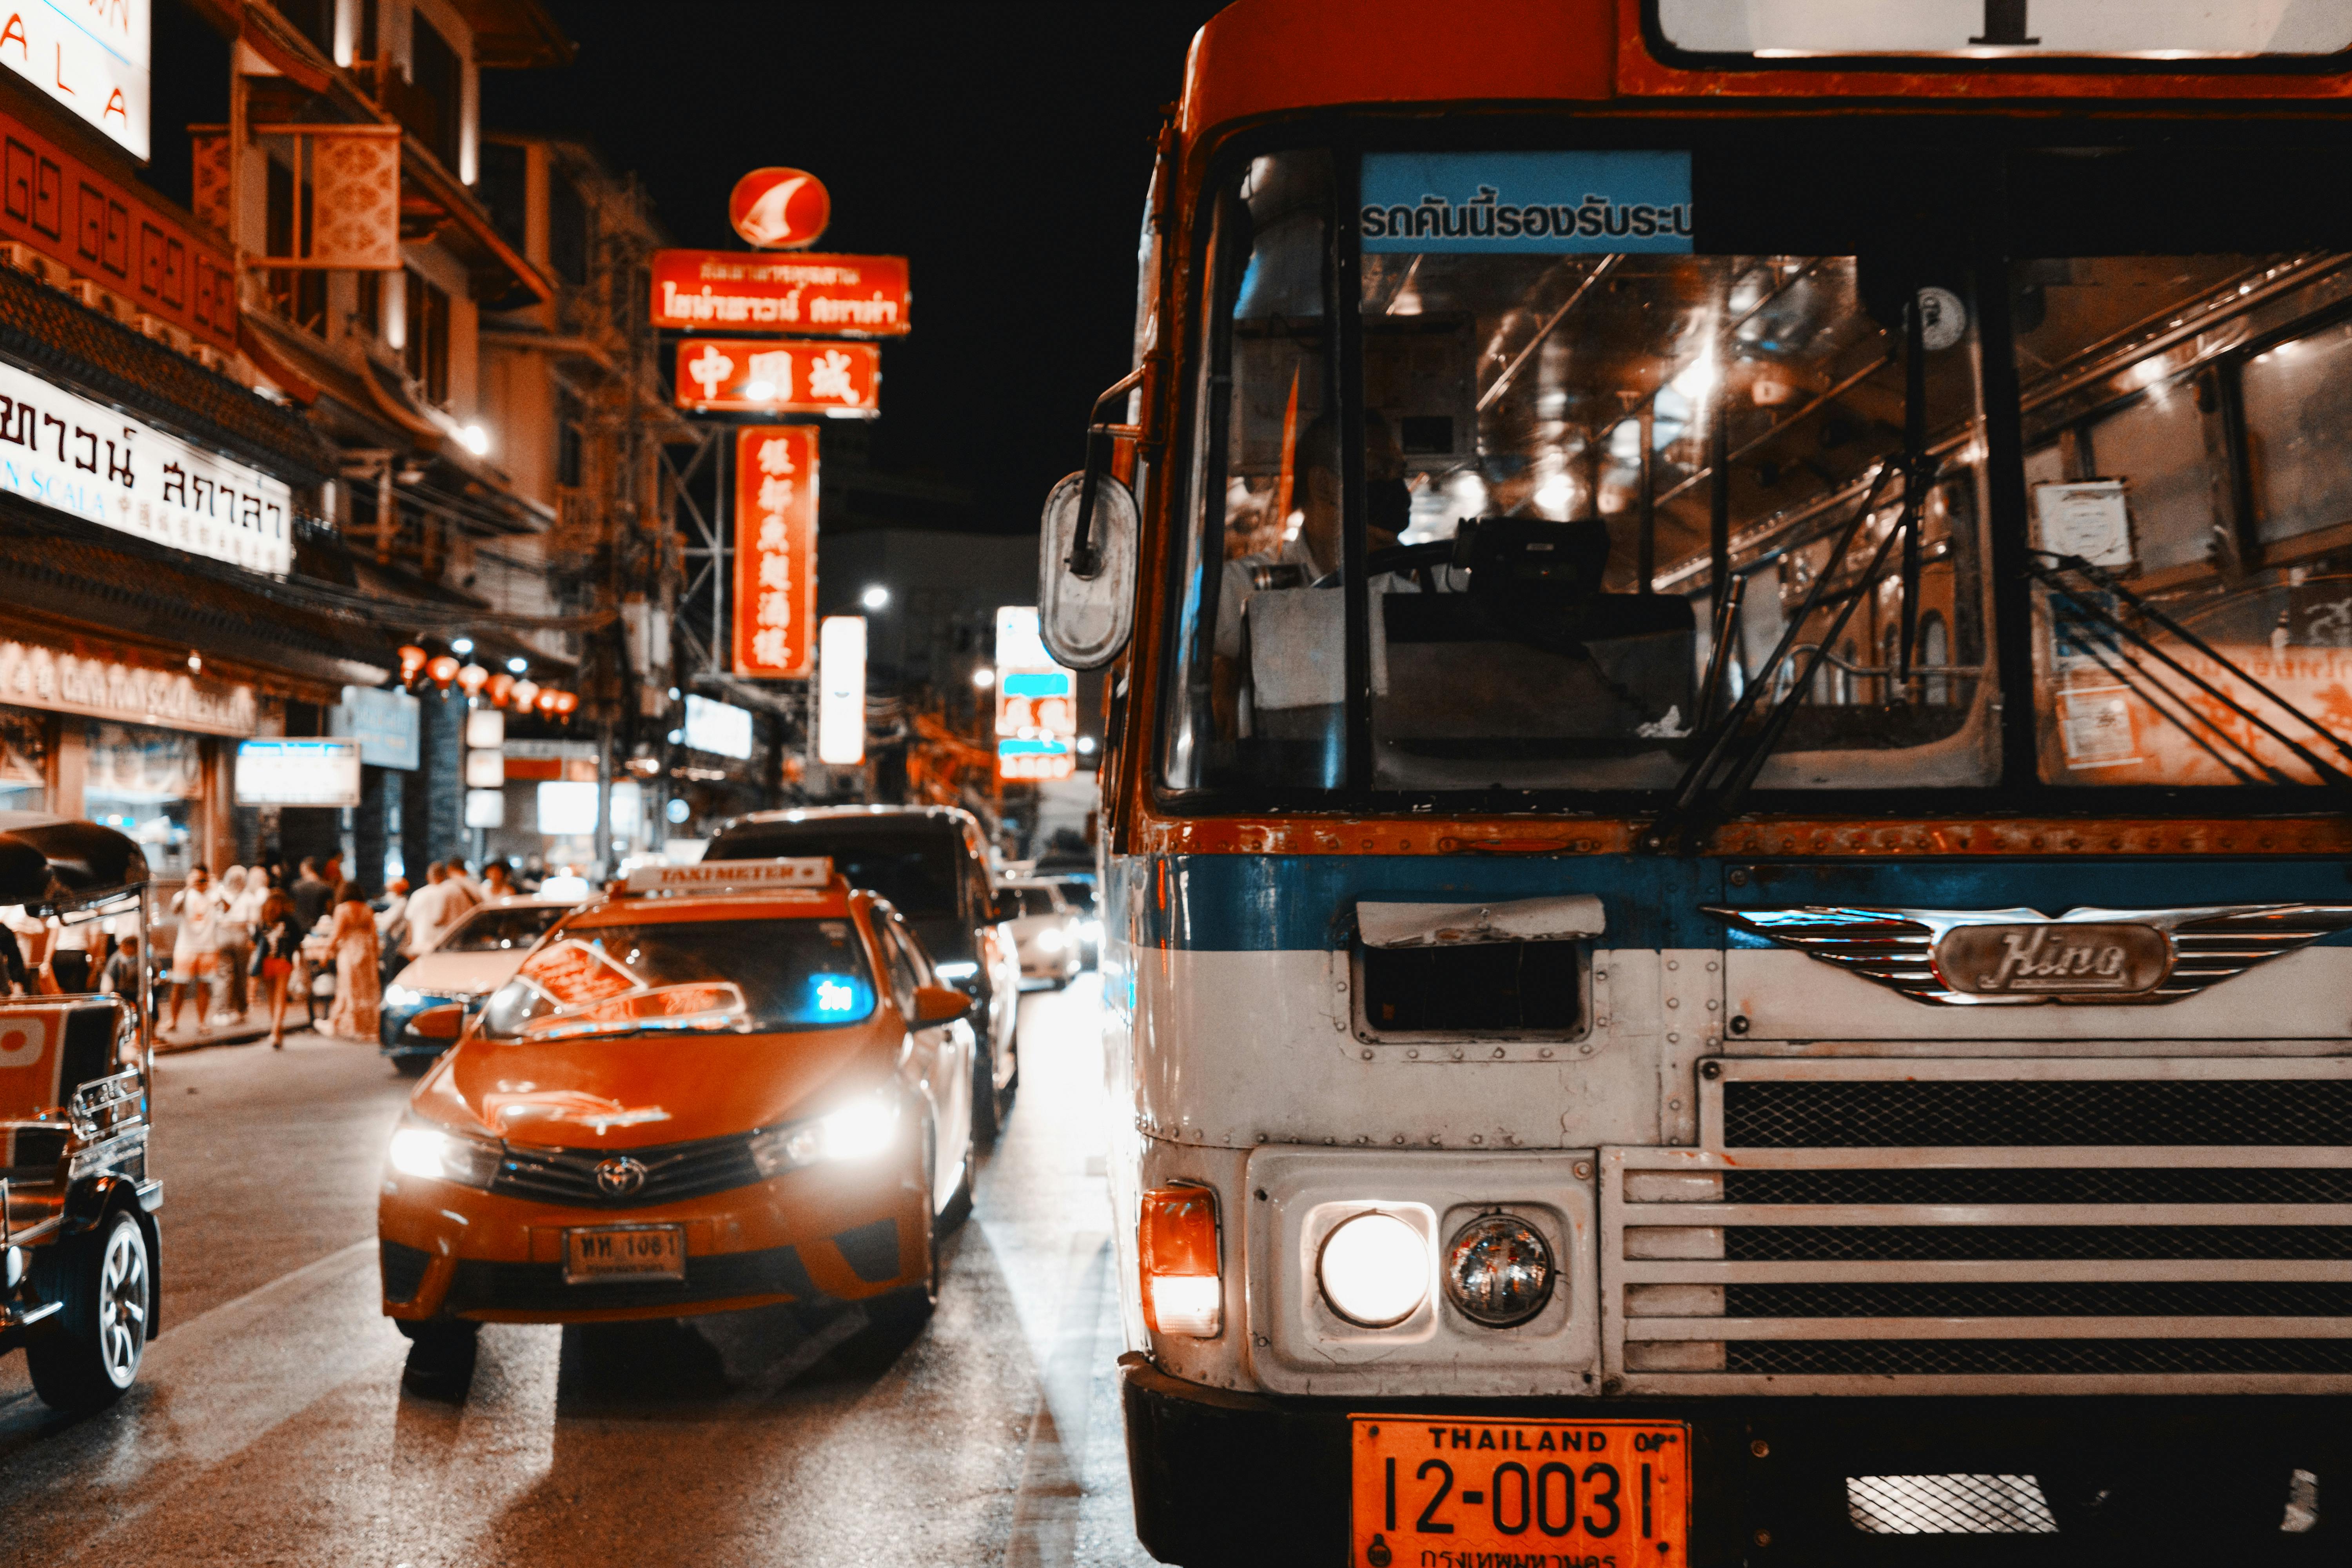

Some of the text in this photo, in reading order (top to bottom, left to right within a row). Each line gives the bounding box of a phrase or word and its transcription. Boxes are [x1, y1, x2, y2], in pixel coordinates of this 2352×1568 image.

[1977, 927, 2128, 989] Hino
[1428, 1427, 1607, 1452] THAILAND
[1385, 1457, 1651, 1539] 12-0031
